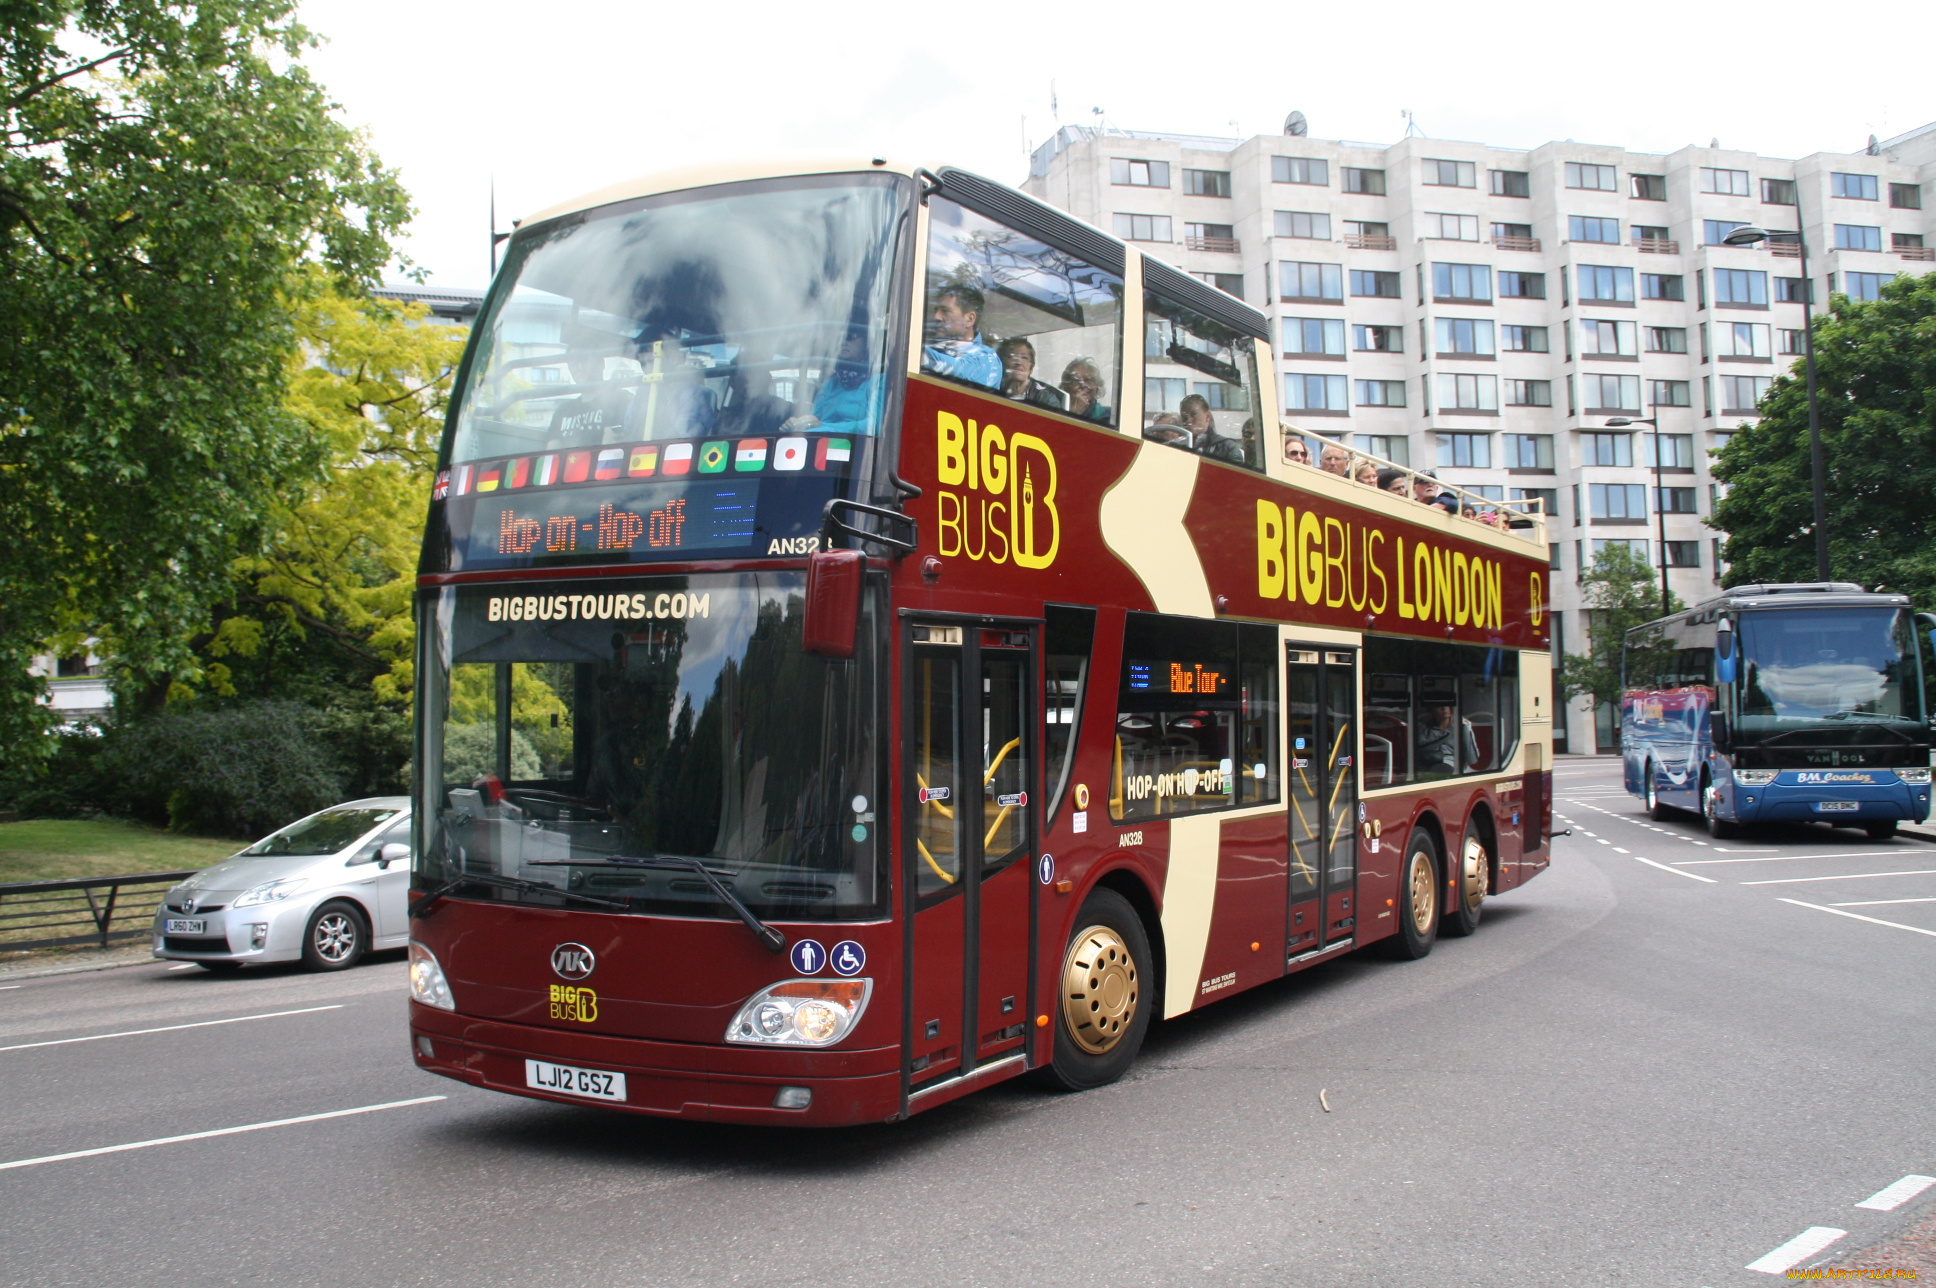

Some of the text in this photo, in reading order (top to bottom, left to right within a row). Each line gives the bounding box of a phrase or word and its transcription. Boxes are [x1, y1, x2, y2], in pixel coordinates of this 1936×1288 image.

[937, 410, 1008, 495] BIG
[499, 510, 541, 554] Hop
[546, 515, 576, 552] on
[598, 503, 643, 549] Hop
[649, 499, 686, 547] off
[938, 490, 1009, 564] BUS
[1397, 536, 1502, 630] LONDON
[488, 593, 710, 622] BIGBUSTOURS.COM
[1170, 662, 1193, 693] Blue
[1127, 769, 1225, 801] HOP-ON HOP-OFF
[1797, 772, 1872, 783] BM Coaches
[1118, 830, 1143, 848] AN328
[550, 984, 577, 1004] BIG
[1201, 971, 1236, 988] BIG BUS TOURS
[550, 1002, 577, 1021] BUS
[536, 1064, 615, 1096] LJ12 GSZ
